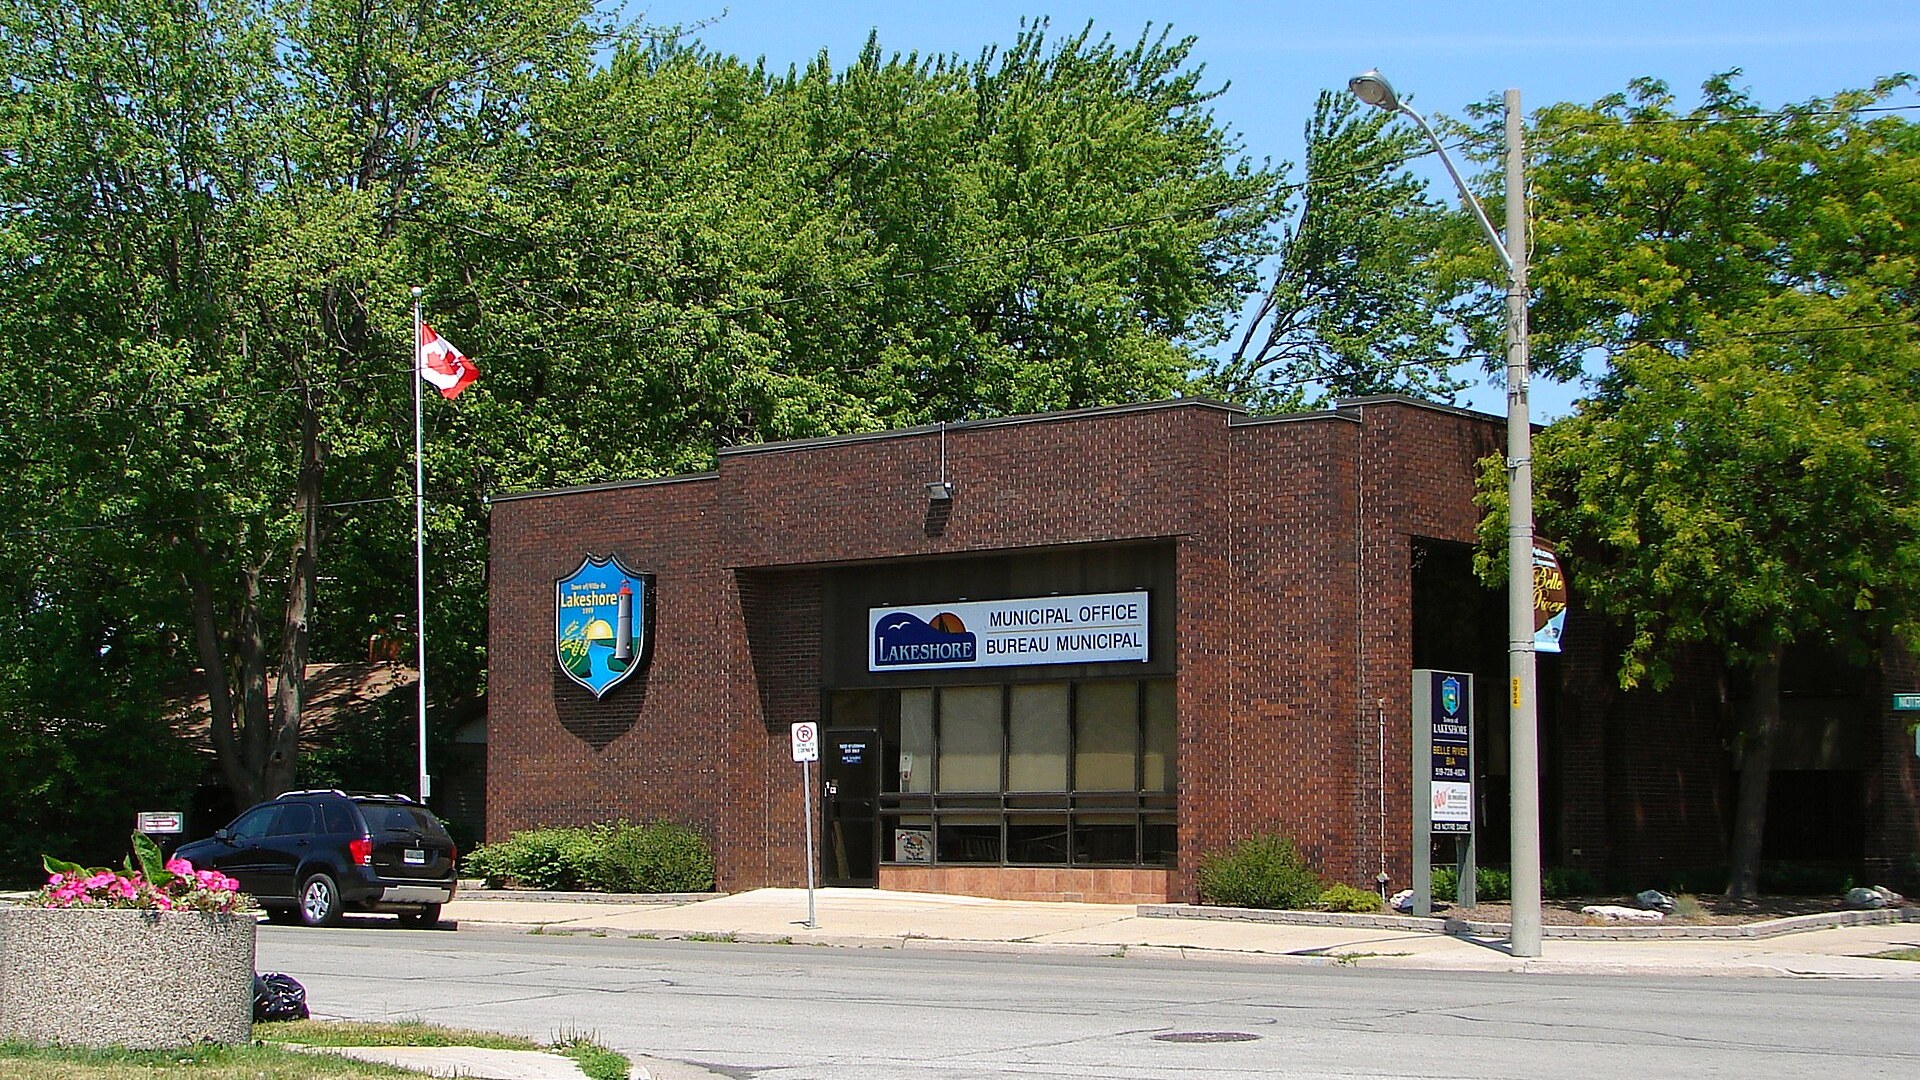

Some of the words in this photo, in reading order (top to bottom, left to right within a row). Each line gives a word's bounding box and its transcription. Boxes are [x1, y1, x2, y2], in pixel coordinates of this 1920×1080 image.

[1533, 566, 1563, 590] Belle
[561, 591, 618, 608] Lakeshore
[989, 607, 1073, 627] MUNICIPAL
[1079, 603, 1138, 622] OFFICE
[878, 636, 973, 662] LAKESHORE
[986, 636, 1049, 656] BUREAU
[1056, 632, 1143, 652] MUNICIPAL
[1433, 724, 1468, 735] LAKESHORE
[1433, 745, 1451, 755] BELLE
[1452, 746, 1468, 756] RIVER
